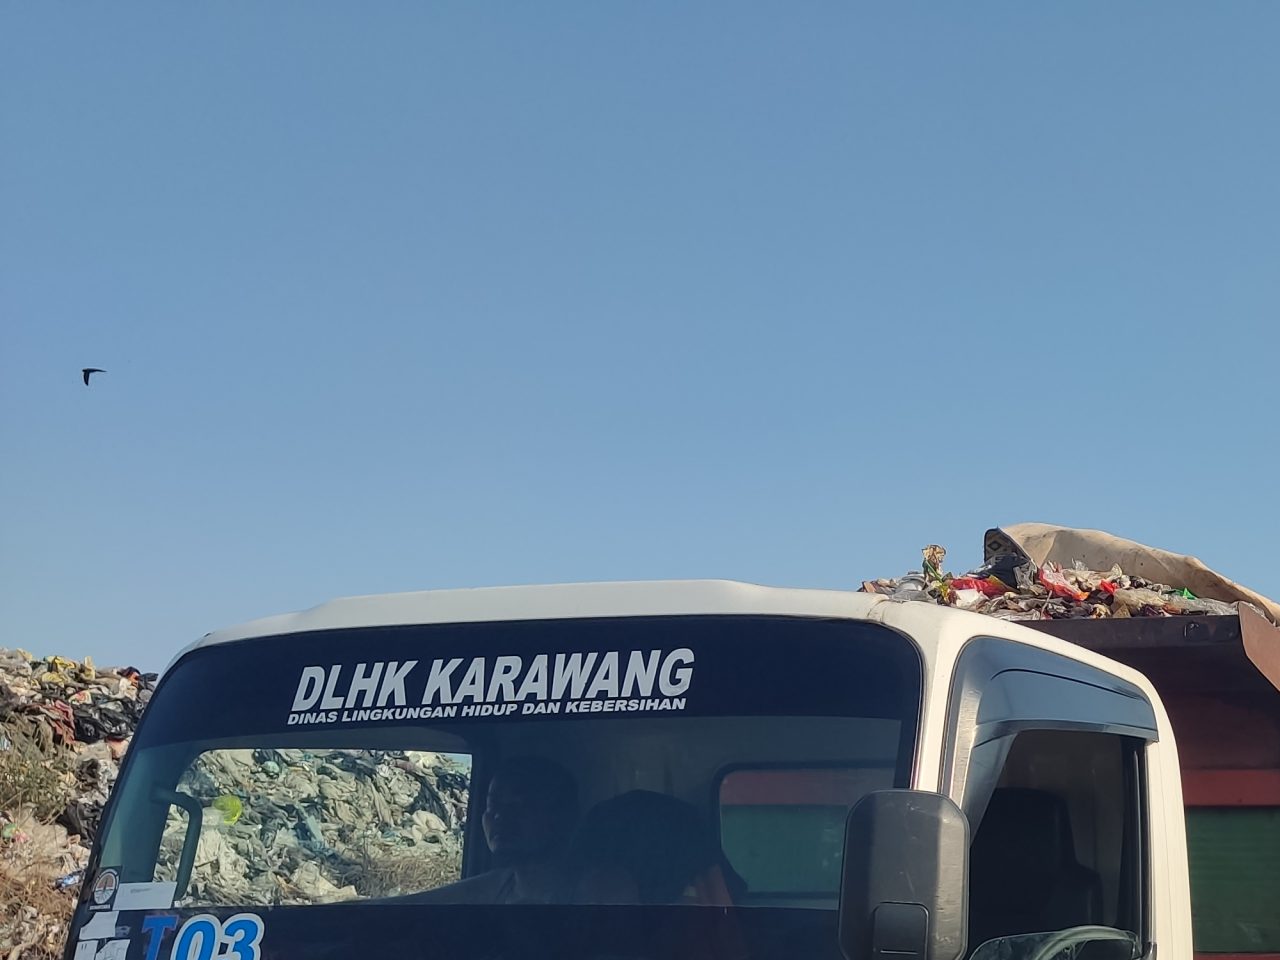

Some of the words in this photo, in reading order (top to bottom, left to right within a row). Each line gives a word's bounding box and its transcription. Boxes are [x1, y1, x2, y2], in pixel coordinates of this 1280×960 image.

[291, 660, 418, 711] DLHK
[422, 648, 695, 705] KARAWANG
[287, 711, 338, 725] DINAS
[341, 706, 457, 722] LINGKUNGAN
[461, 703, 517, 717] HIDUP
[522, 701, 561, 715] DAN
[565, 698, 687, 713] KEBERSIHAN
